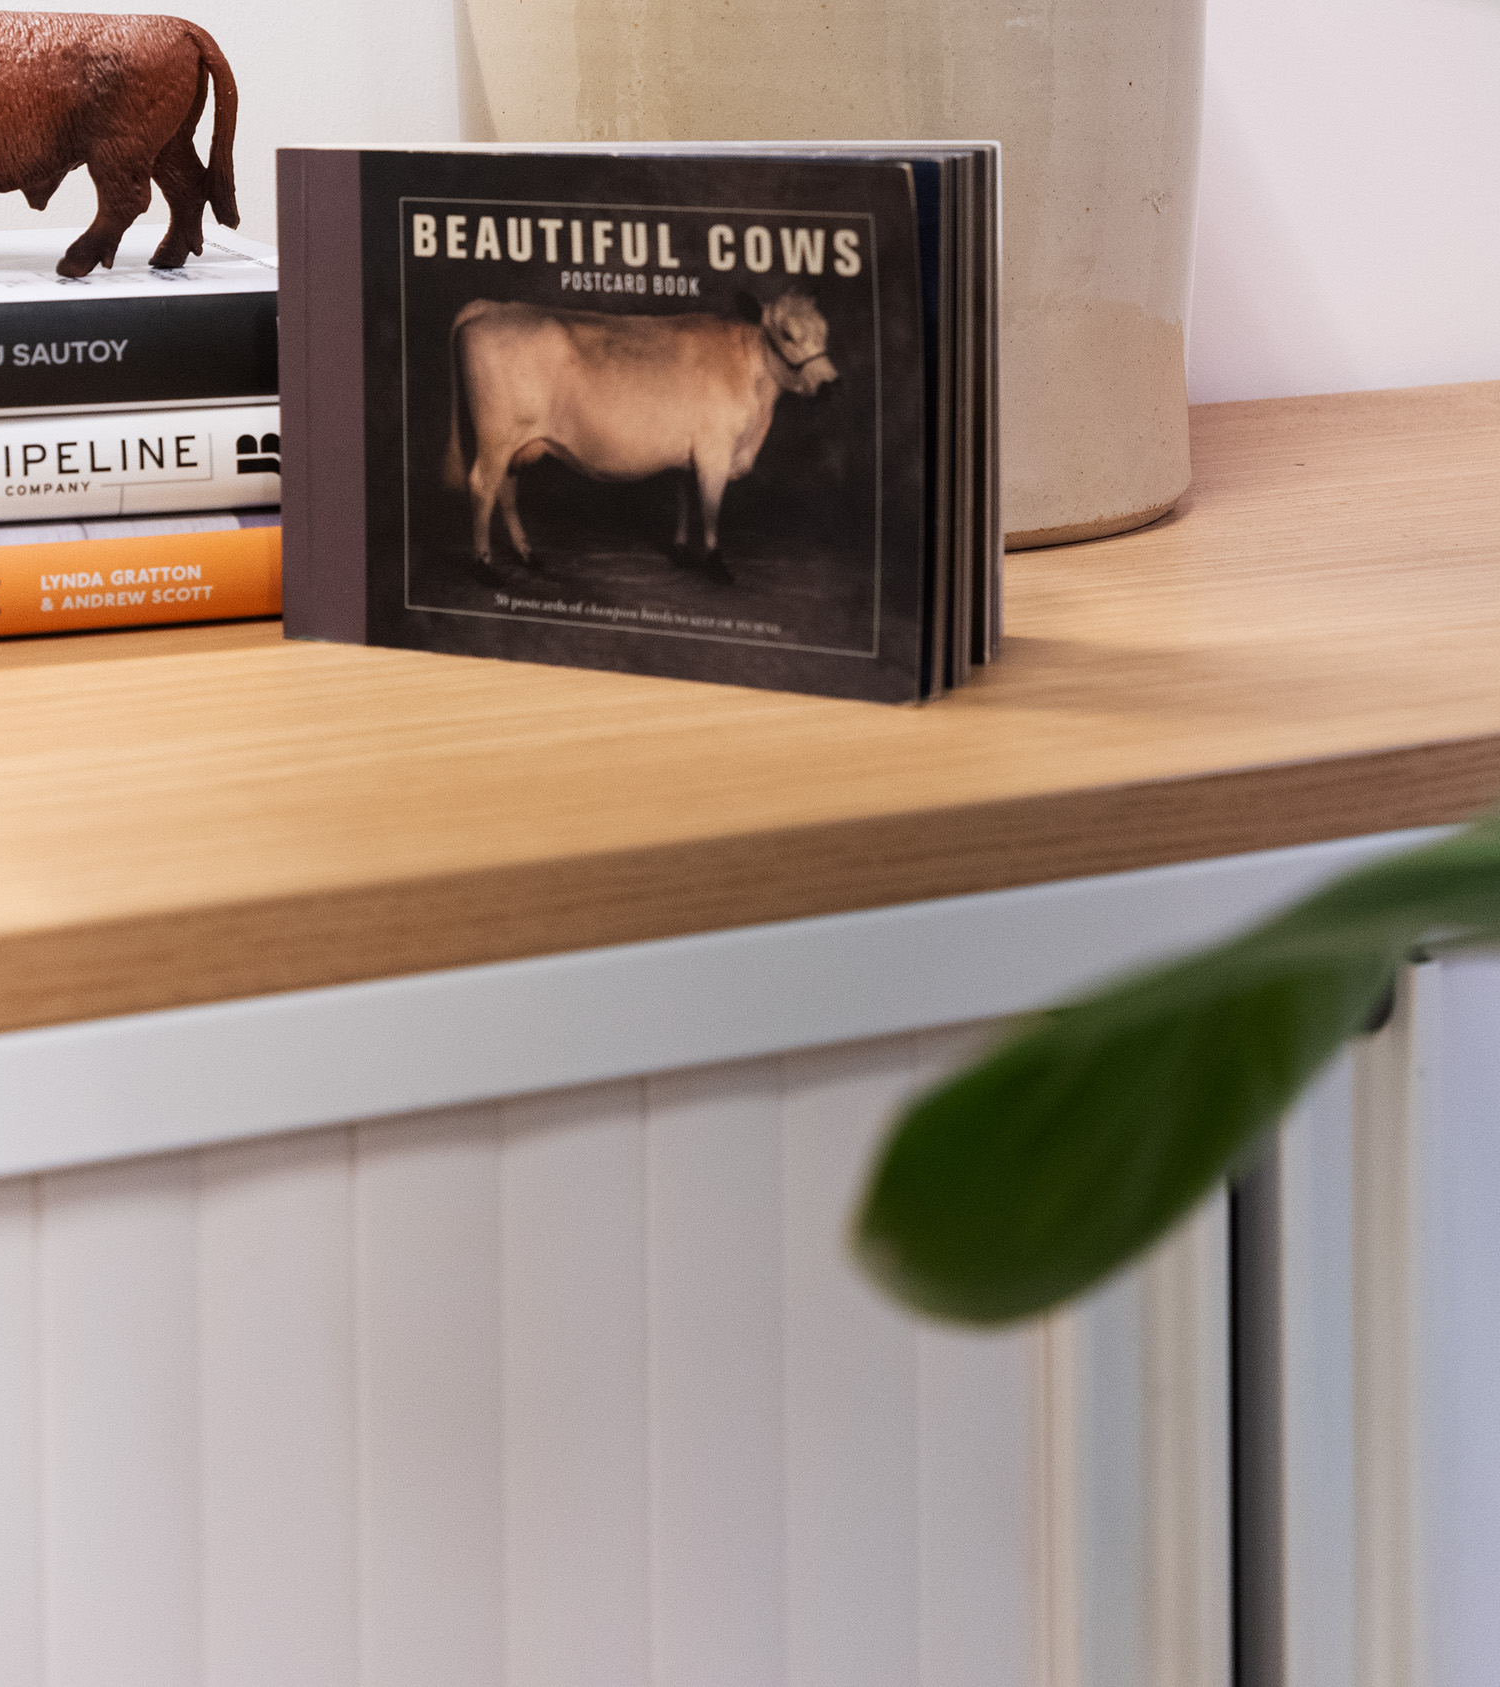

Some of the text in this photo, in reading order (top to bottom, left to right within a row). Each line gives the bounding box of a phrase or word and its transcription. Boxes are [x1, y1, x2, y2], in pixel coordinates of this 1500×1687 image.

[412, 214, 862, 278] BEAUTIFUL COWS
[560, 270, 700, 297] POSTCARD BOOK
[12, 339, 129, 367] SAUTOY
[4, 480, 91, 498] COMPANY
[41, 564, 202, 591] LYNDA GRATTON
[41, 585, 214, 612] & ANDREW SCOTT
